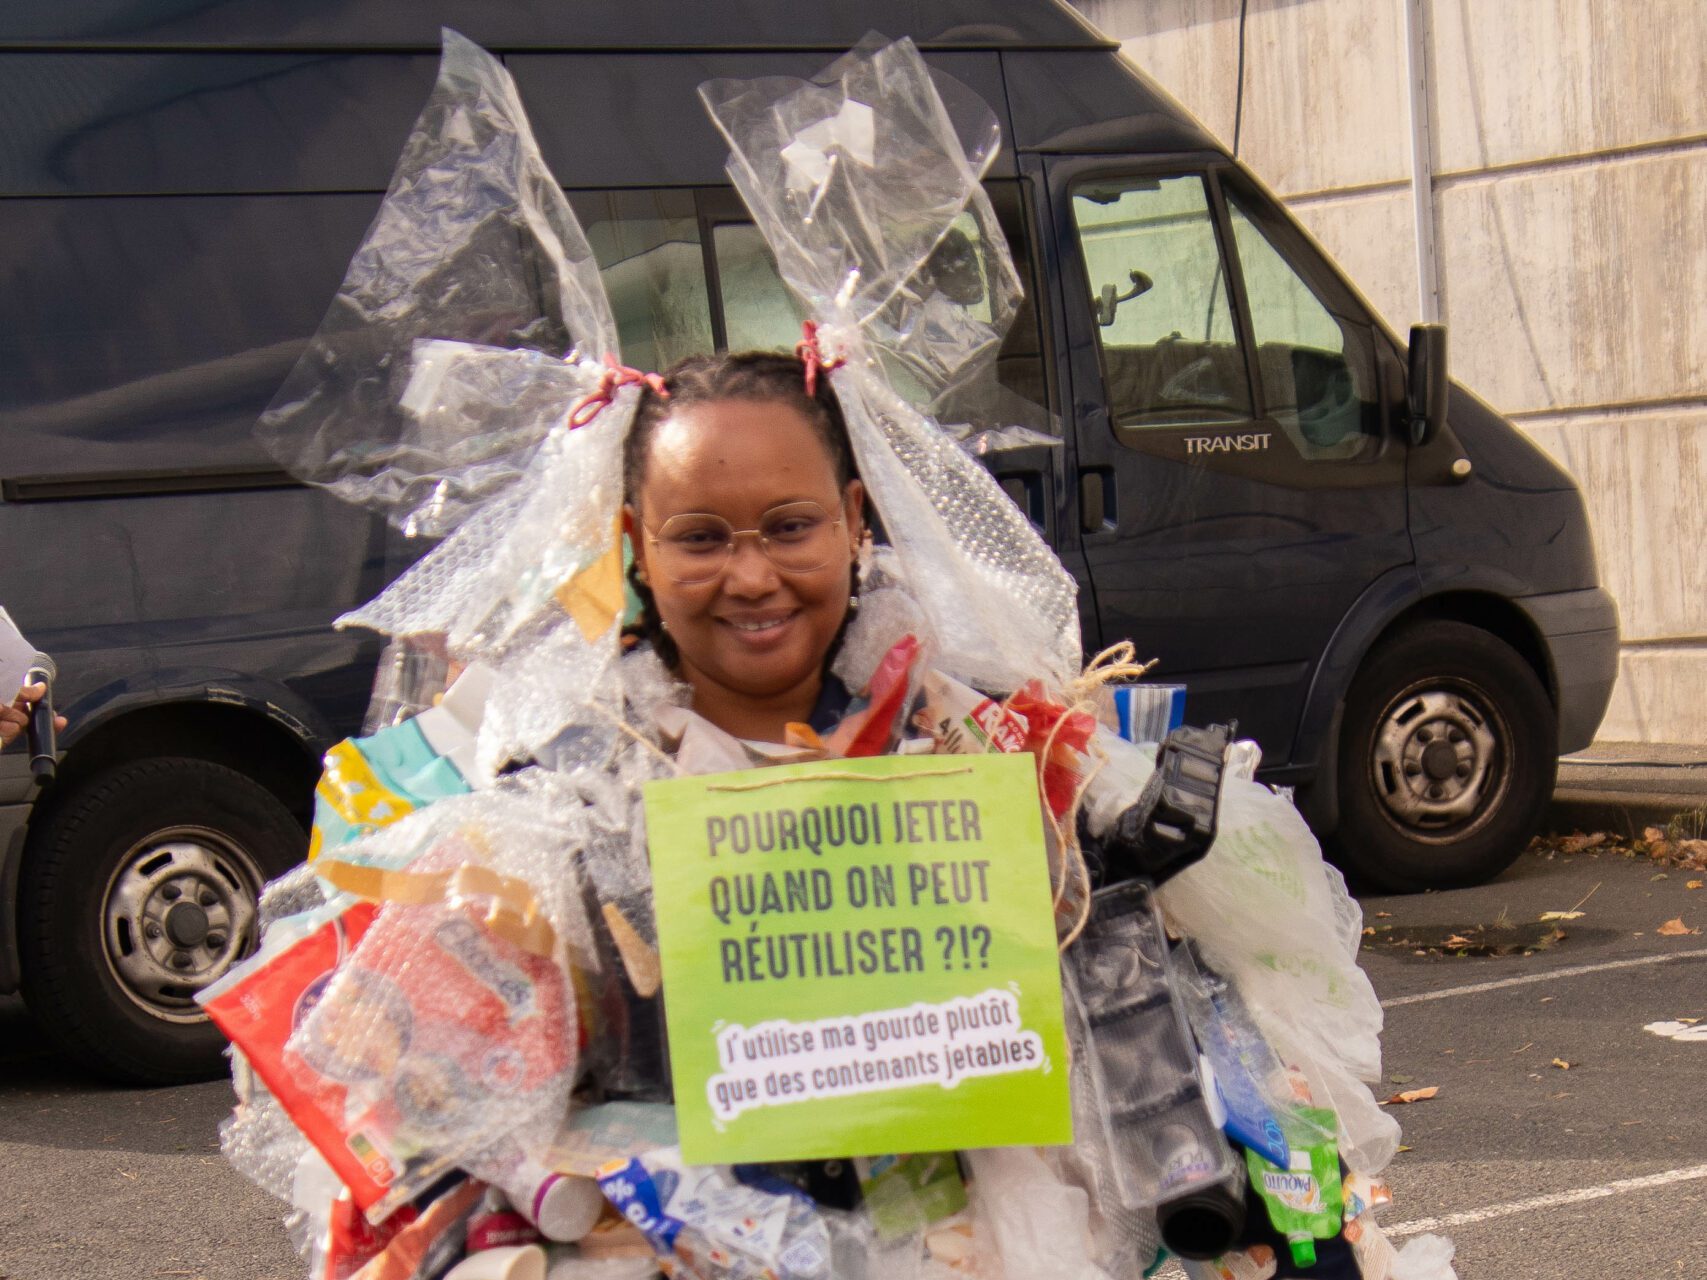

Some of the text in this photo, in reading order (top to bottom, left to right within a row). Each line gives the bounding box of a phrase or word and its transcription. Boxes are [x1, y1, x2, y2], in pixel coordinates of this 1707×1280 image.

[1184, 433, 1272, 454] TRANSIT
[705, 799, 983, 858] POURQUOI JETER
[709, 859, 992, 925] QUAND ON PEUT
[719, 920, 993, 984] RÉUTILISER ?!?
[822, 1024, 857, 1050] ma
[862, 1006, 940, 1053] gourde
[946, 996, 1014, 1039] plutôt
[715, 1036, 1037, 1113] que des contenants jetables
